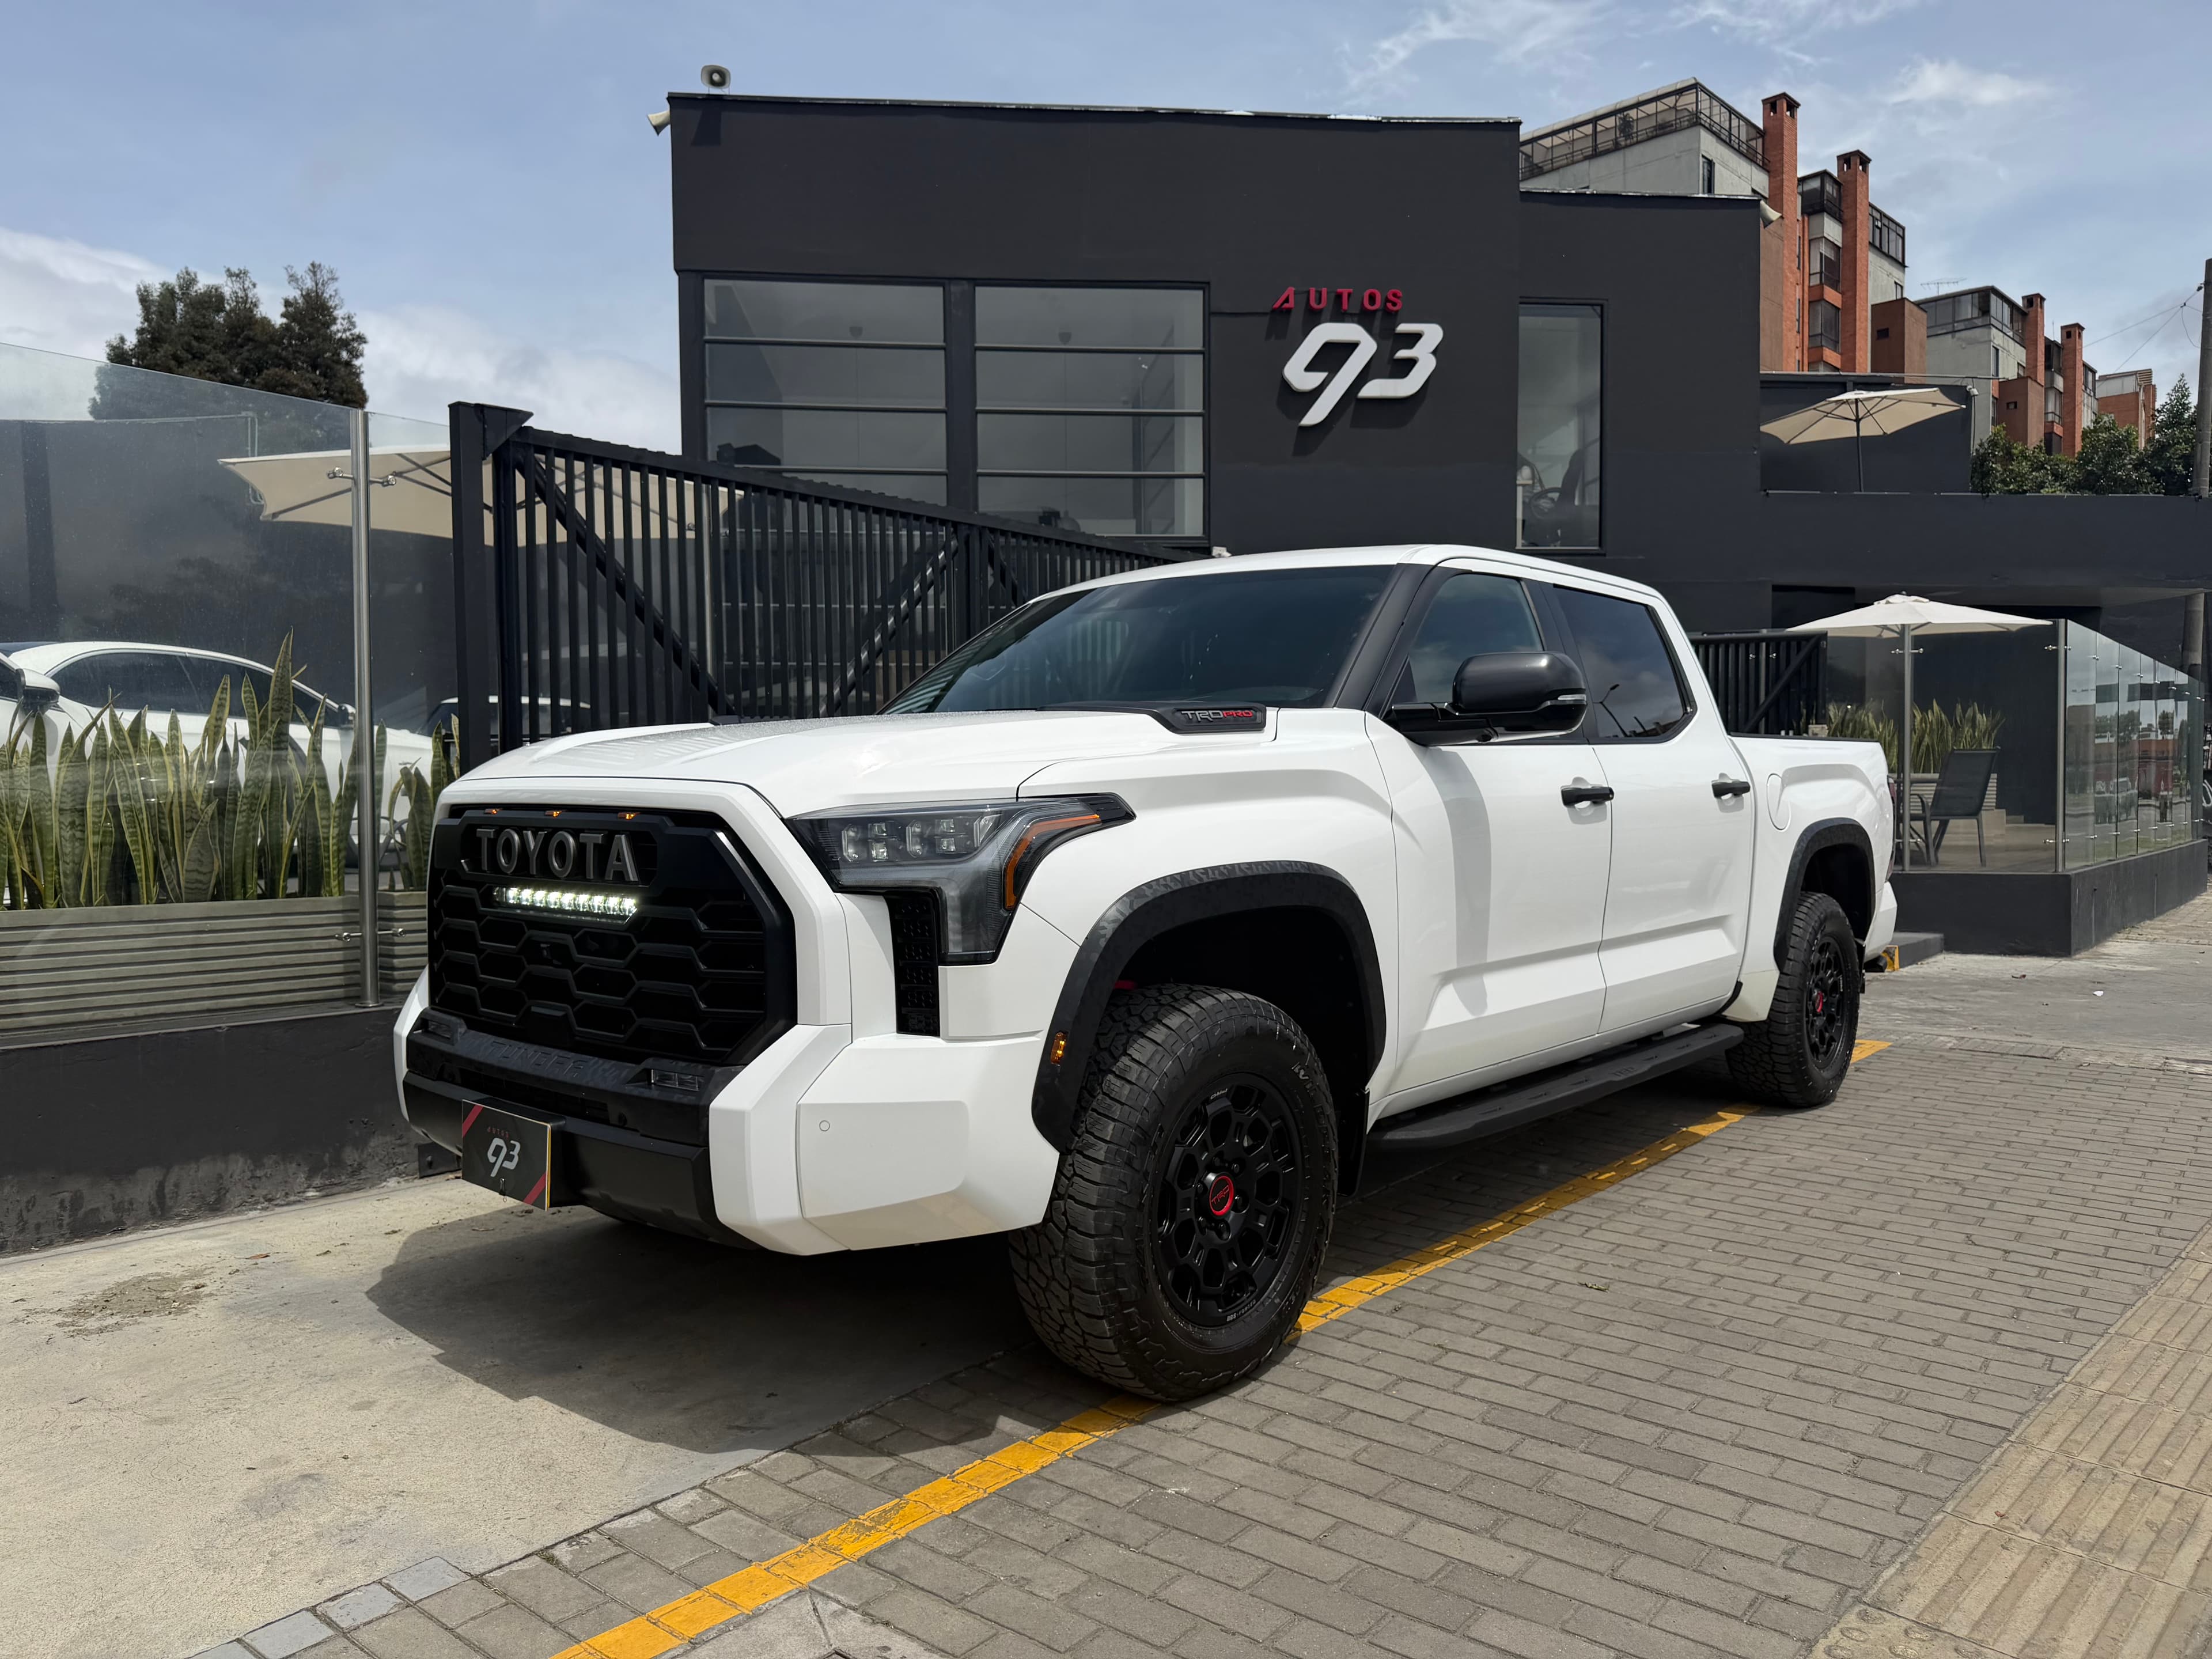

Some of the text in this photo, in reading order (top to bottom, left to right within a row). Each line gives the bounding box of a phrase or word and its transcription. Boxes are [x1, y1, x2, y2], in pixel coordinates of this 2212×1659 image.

[1272, 286, 1403, 312] AUTOS
[1282, 322, 1444, 427] 93
[1181, 710, 1253, 722] TRD PRO
[476, 828, 639, 882] TOYOTA
[488, 1041, 588, 1078] TUNDRA
[487, 1137, 521, 1177] 93
[1211, 1184, 1230, 1205] TRD
